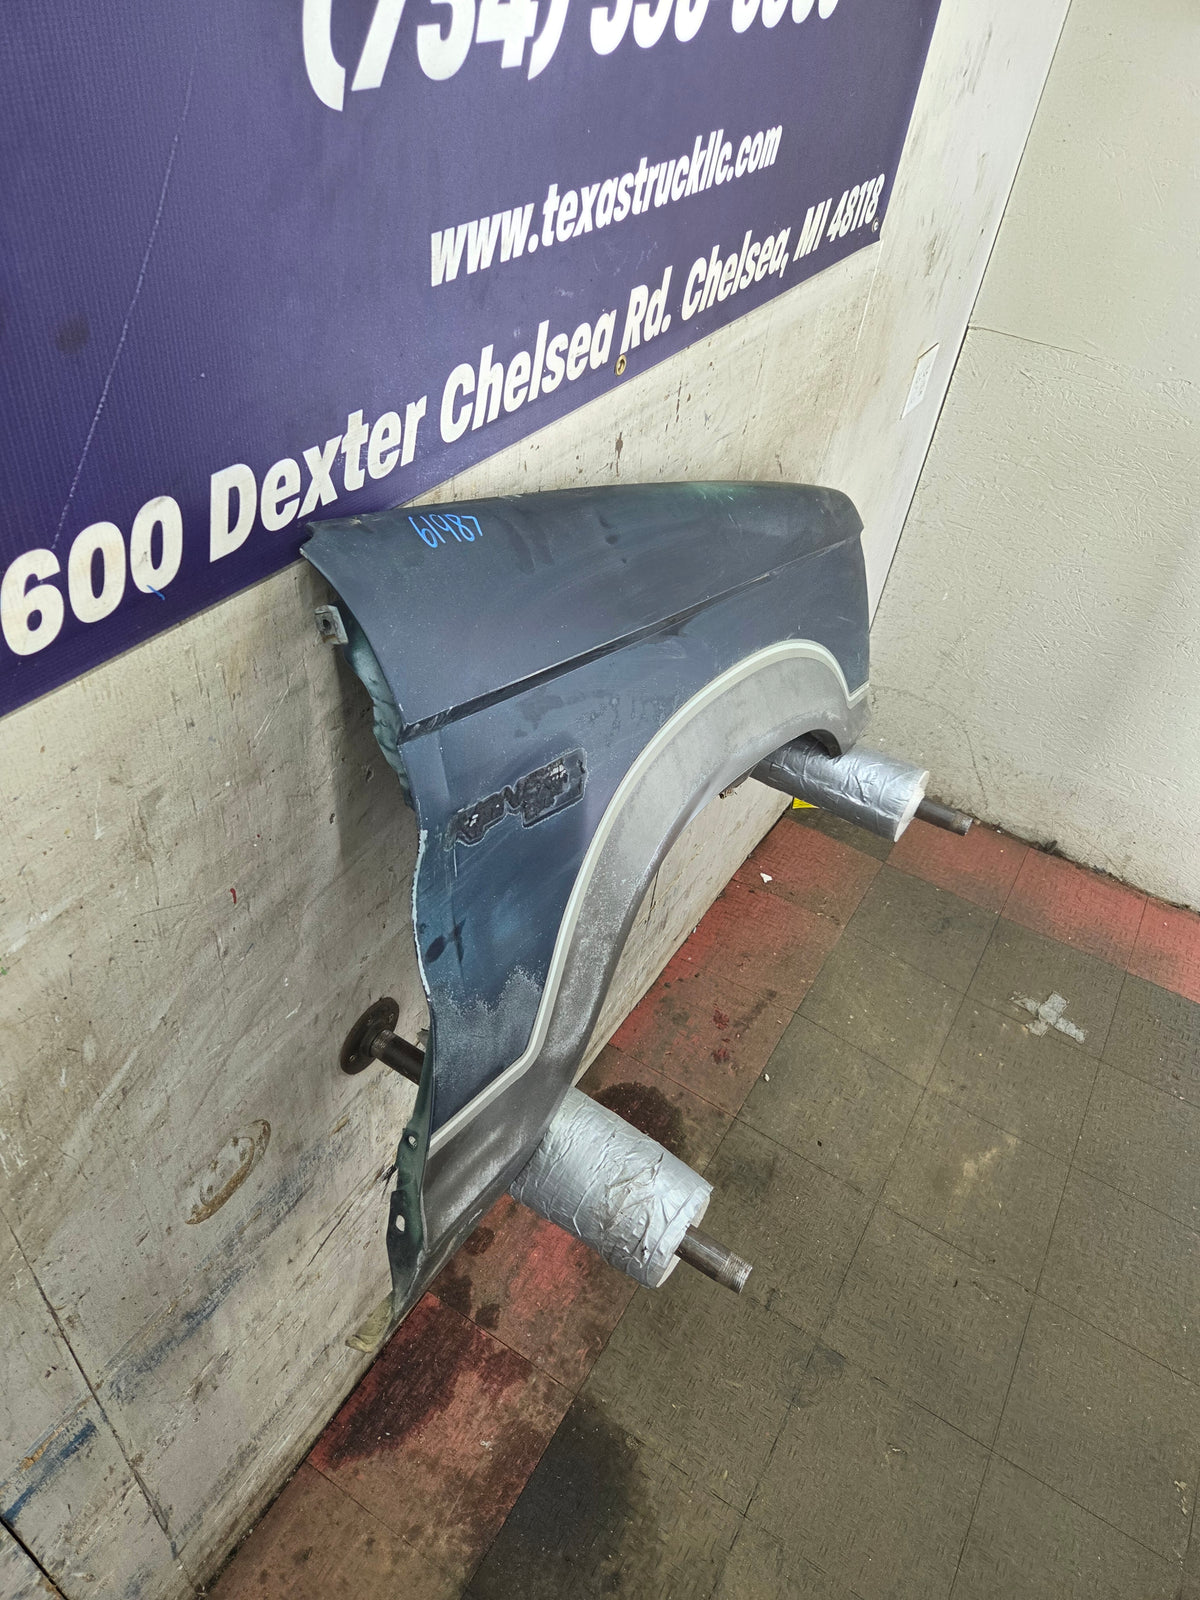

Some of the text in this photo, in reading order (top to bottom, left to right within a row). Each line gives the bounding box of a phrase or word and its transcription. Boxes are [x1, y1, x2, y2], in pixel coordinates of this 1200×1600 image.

[431, 125, 783, 288] www.texastruckllc.com
[0, 173, 886, 656] 600 Dexter Chelsea Rd. Chelsea, MI 48118
[408, 514, 483, 548] 61987
